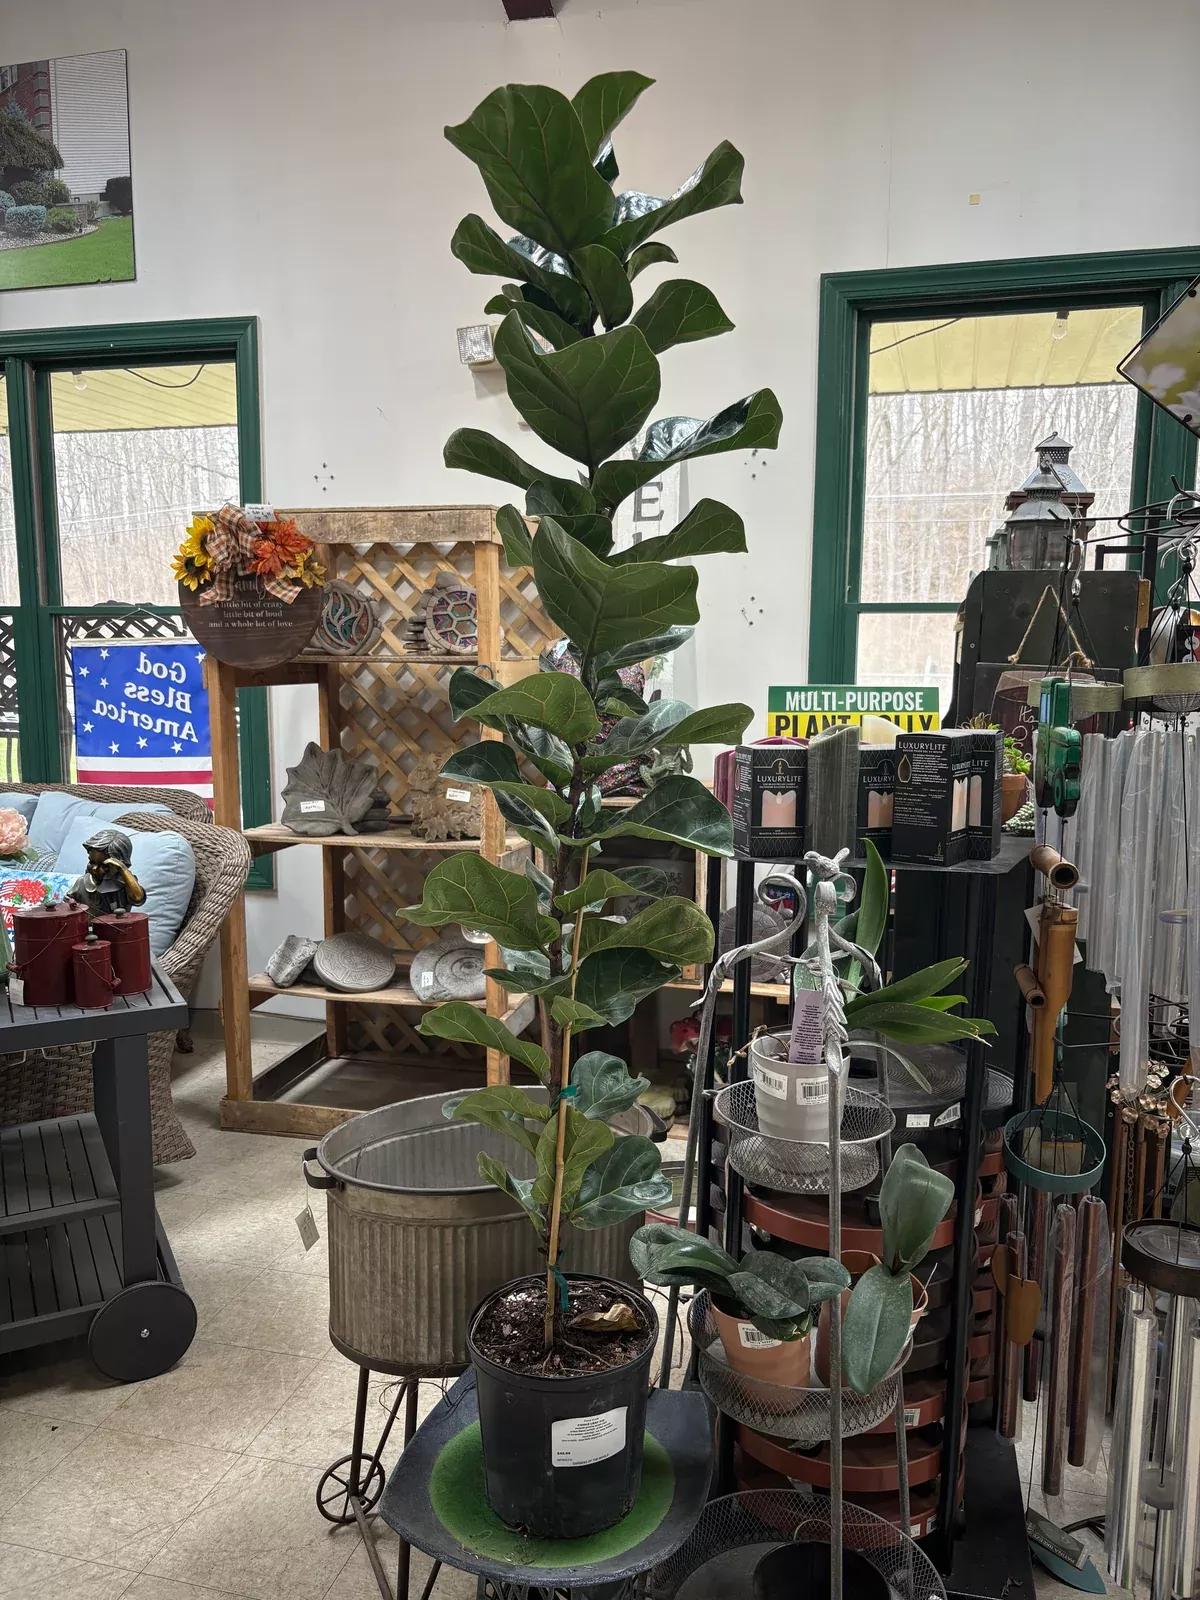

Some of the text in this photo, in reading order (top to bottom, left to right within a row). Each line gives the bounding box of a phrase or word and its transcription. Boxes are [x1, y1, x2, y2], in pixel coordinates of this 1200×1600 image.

[253, 600, 261, 608] of
[223, 610, 283, 618] little bit of loud
[208, 620, 223, 628] and
[230, 620, 254, 628] whole
[785, 691, 924, 712] MULTI-PURPOSE
[757, 775, 802, 783] LUXURYLITE
